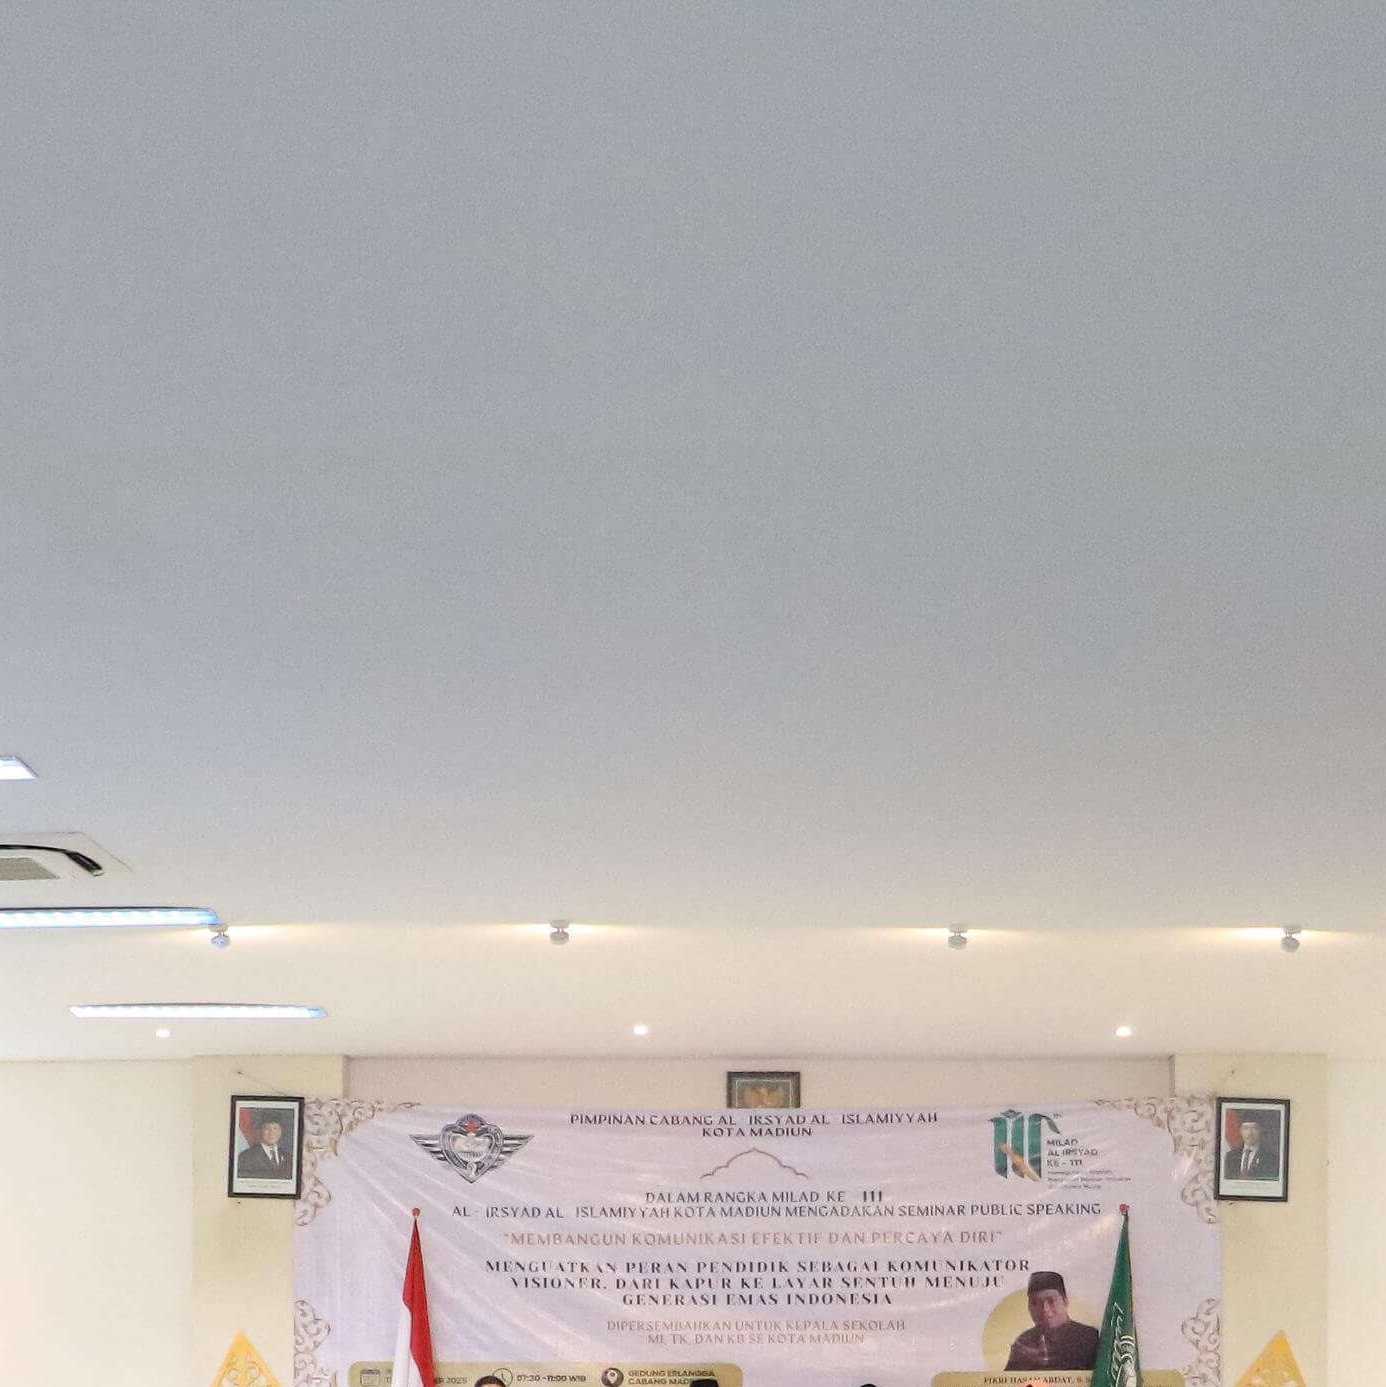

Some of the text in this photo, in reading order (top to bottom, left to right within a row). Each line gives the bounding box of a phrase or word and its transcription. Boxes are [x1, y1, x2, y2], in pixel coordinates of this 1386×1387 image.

[570, 1113, 645, 1125] PIMPINAN
[650, 1114, 713, 1126] CABANG
[749, 1114, 807, 1126] IRSYAD
[842, 1112, 938, 1125] ISLAMIYYAH
[702, 1127, 813, 1137] KOTA MADIUN
[1046, 1138, 1079, 1147] MILAD
[646, 1191, 700, 1203] DALAM
[704, 1191, 767, 1203] RANGKA
[771, 1190, 820, 1202] MILAD
[826, 1190, 845, 1202] KE
[486, 1206, 541, 1218] IRSYAD
[545, 1206, 564, 1218] AL
[576, 1205, 671, 1218] ISLAMIYYAH
[674, 1205, 716, 1218] KOTA
[720, 1205, 782, 1218] MADIUN
[785, 1204, 895, 1217] MENGADAKAN
[898, 1204, 966, 1216] SEMINAR
[970, 1203, 1022, 1216] PUBLIC
[1026, 1203, 1102, 1216] SPEAKING
[632, 1231, 746, 1246] KOMUNIKASI
[752, 1231, 821, 1245] EFEKTIF
[828, 1231, 864, 1245] DAN
[871, 1231, 953, 1244] PERCAYA
[485, 1259, 1030, 1273] MENGUATKAN PERAN PENDIDIK SEBAGAI KOMUNIKATOR
[616, 1278, 660, 1289] DARI
[669, 1277, 731, 1289] KAPUR
[741, 1277, 764, 1289] KE
[772, 1277, 833, 1288] LAYAR
[841, 1277, 915, 1288] SENTUH
[925, 1275, 1005, 1288] MENUJU
[622, 1293, 892, 1306] GENERASI EMAS INDONESIA
[607, 1319, 905, 1331] DIPERSEMBAHKAN UNTUK KEPALA SEKOLAH
[695, 1333, 723, 1344] DAN
[748, 1333, 763, 1344] SE
[768, 1333, 806, 1344] KOTA
[809, 1333, 864, 1343] MADIUN
